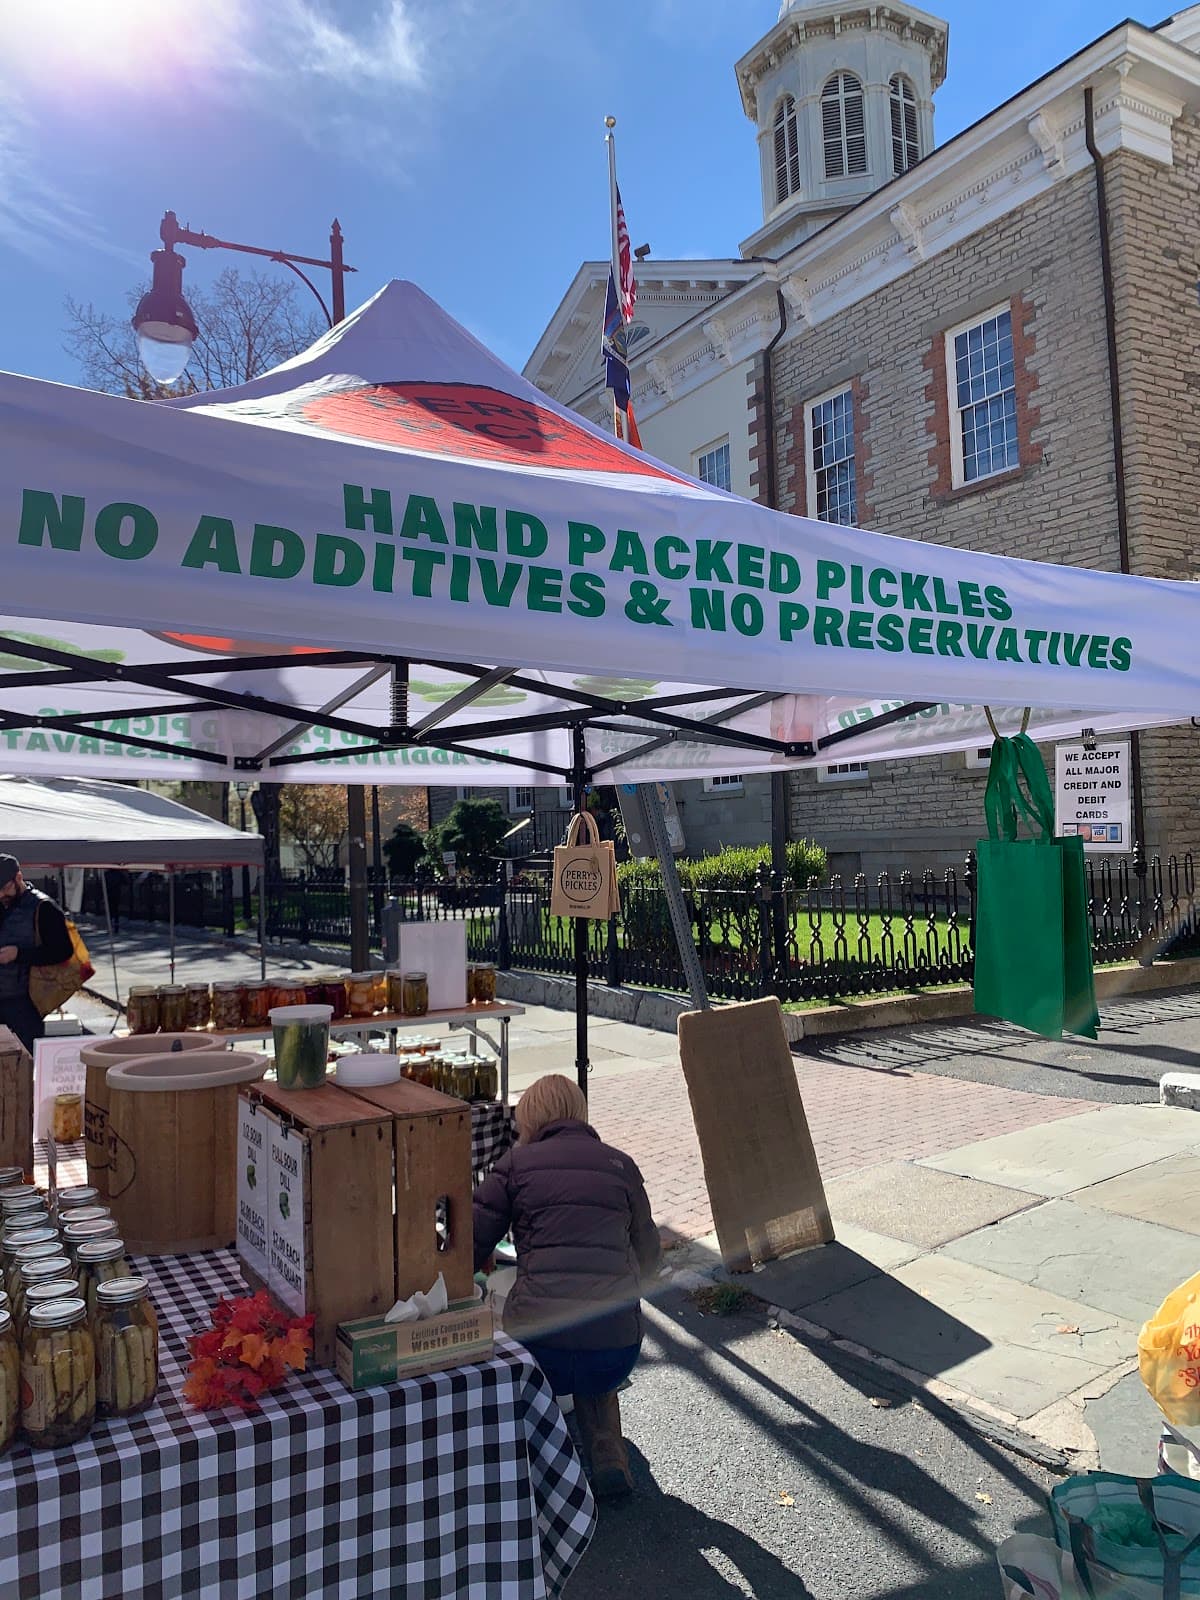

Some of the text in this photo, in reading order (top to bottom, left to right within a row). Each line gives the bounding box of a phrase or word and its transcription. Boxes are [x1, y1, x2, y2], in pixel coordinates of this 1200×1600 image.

[344, 483, 1012, 621] HAND PACKED PICKLES
[18, 488, 1133, 672] NO ADDITIVES & NO PRESERVATIVES
[1065, 751, 1120, 761] WE ACCEPT
[1065, 765, 1120, 776] ALL MAJOR
[1063, 780, 1121, 790] CREDIT AND
[1078, 796, 1107, 804] DEBIT
[1075, 811, 1108, 819] CARDS
[565, 879, 597, 891] PICKLES
[566, 870, 598, 881] PERRY'S
[248, 1145, 257, 1164] DILL
[272, 1143, 298, 1175] FULL SOUR
[280, 1171, 291, 1192] DILL
[252, 1211, 264, 1233] EACH
[250, 1228, 266, 1253] QUART
[286, 1242, 300, 1268] EACH
[284, 1264, 302, 1292] QUART
[411, 1335, 448, 1353] Waste
[452, 1329, 480, 1347] Bags
